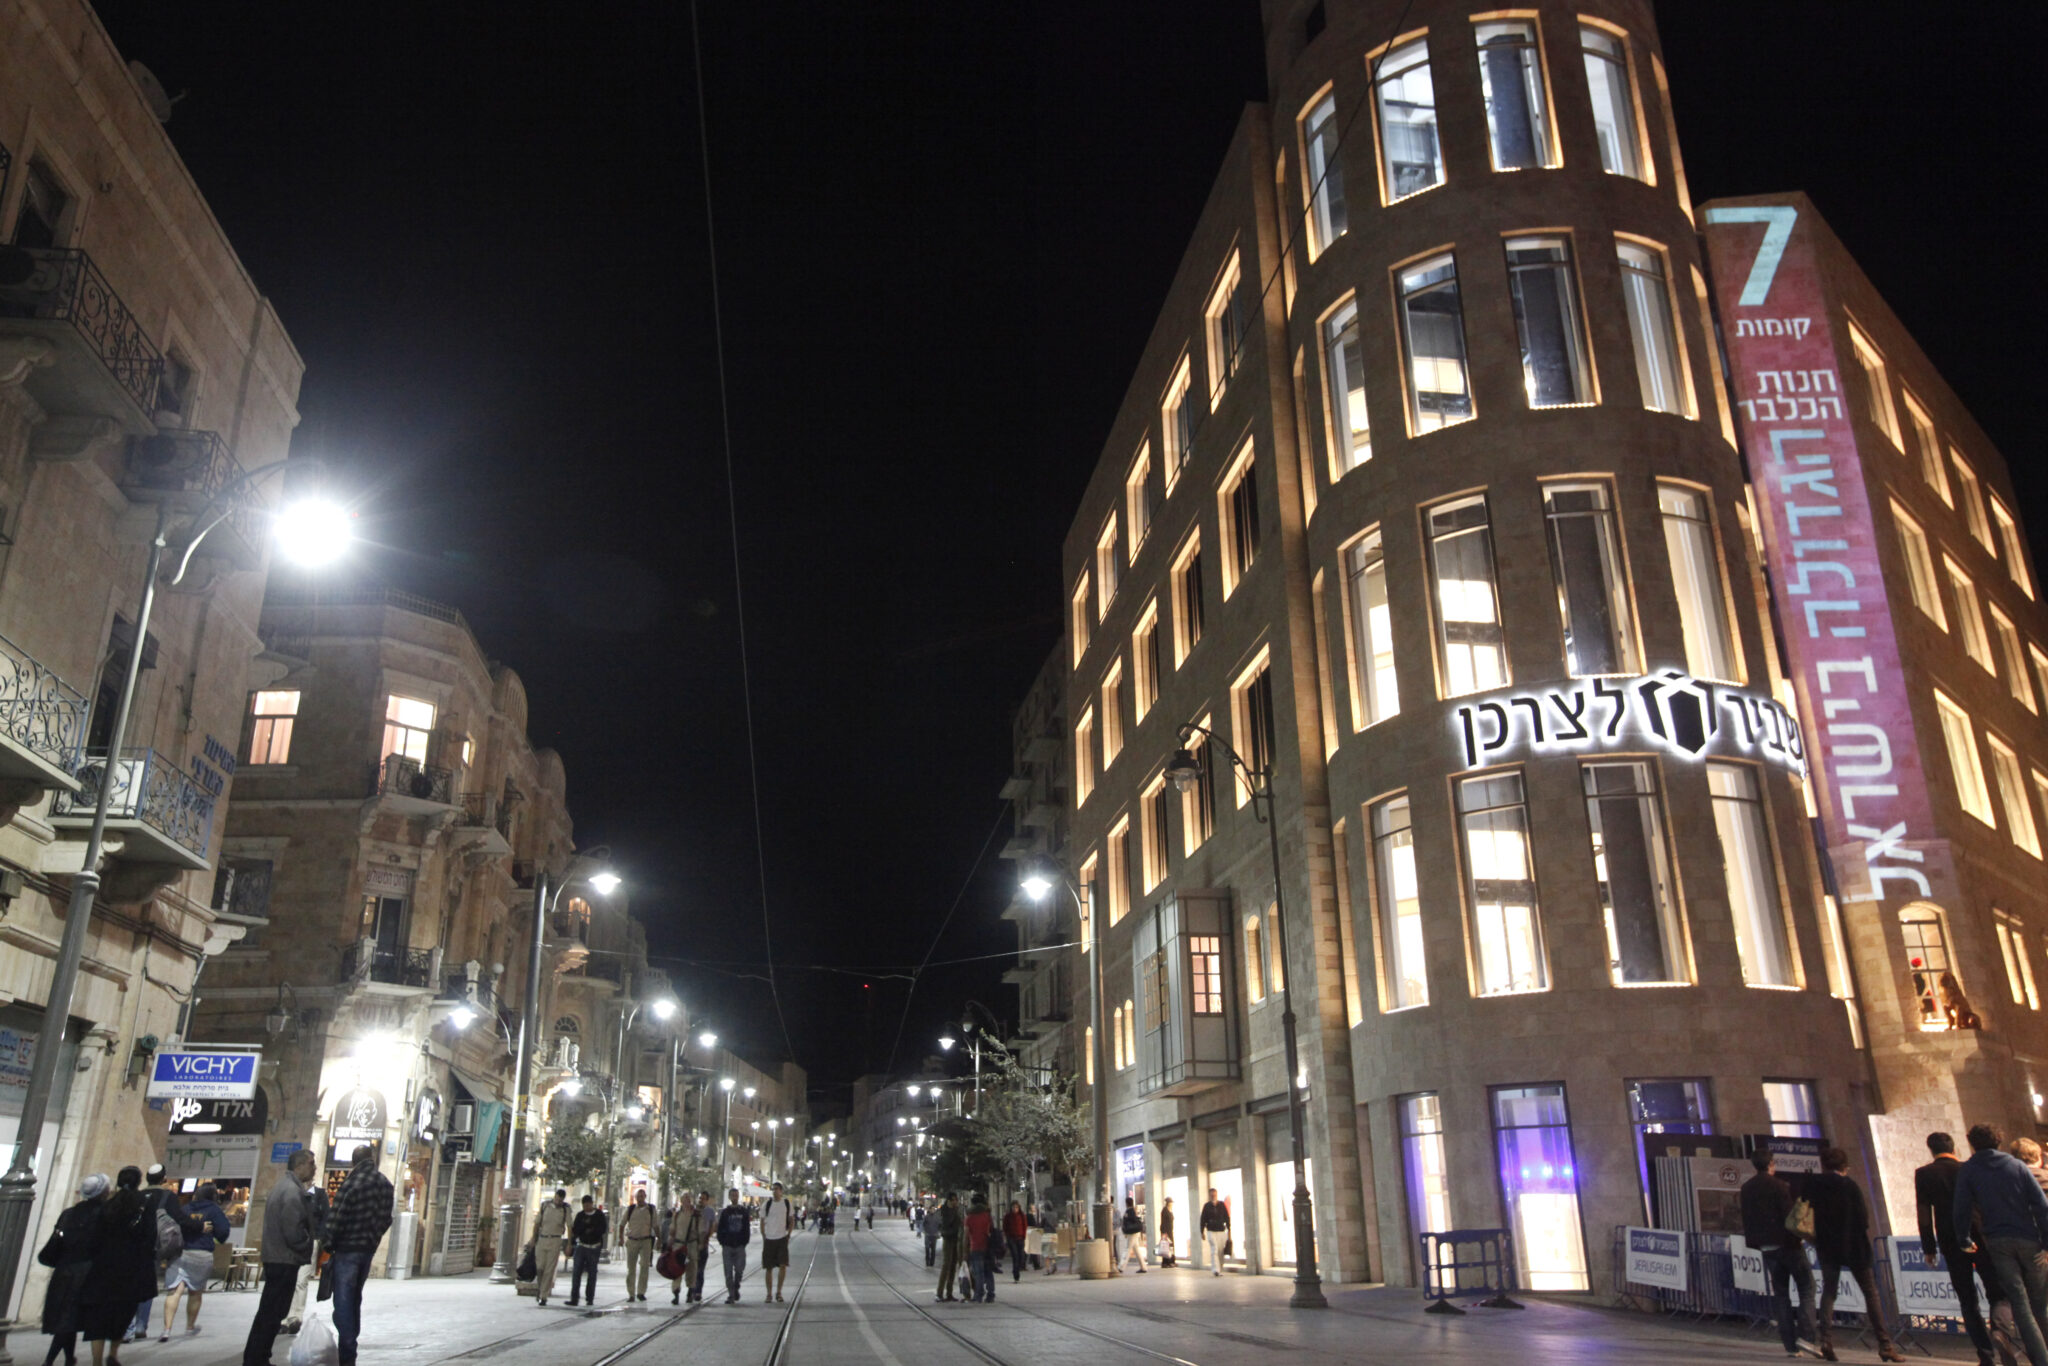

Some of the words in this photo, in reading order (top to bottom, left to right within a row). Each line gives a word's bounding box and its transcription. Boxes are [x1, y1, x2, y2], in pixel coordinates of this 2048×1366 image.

[1705, 206, 1798, 306] 7
[1735, 317, 1811, 341] קומות
[1756, 369, 1837, 394] חנות
[1768, 429, 1867, 639] הגדולה
[1458, 678, 1625, 767] לצרכן
[1816, 655, 1932, 904] בישראל
[171, 1056, 242, 1075] VICHY
[211, 1099, 254, 1118] אלדו
[1733, 1254, 1762, 1273] כניסה
